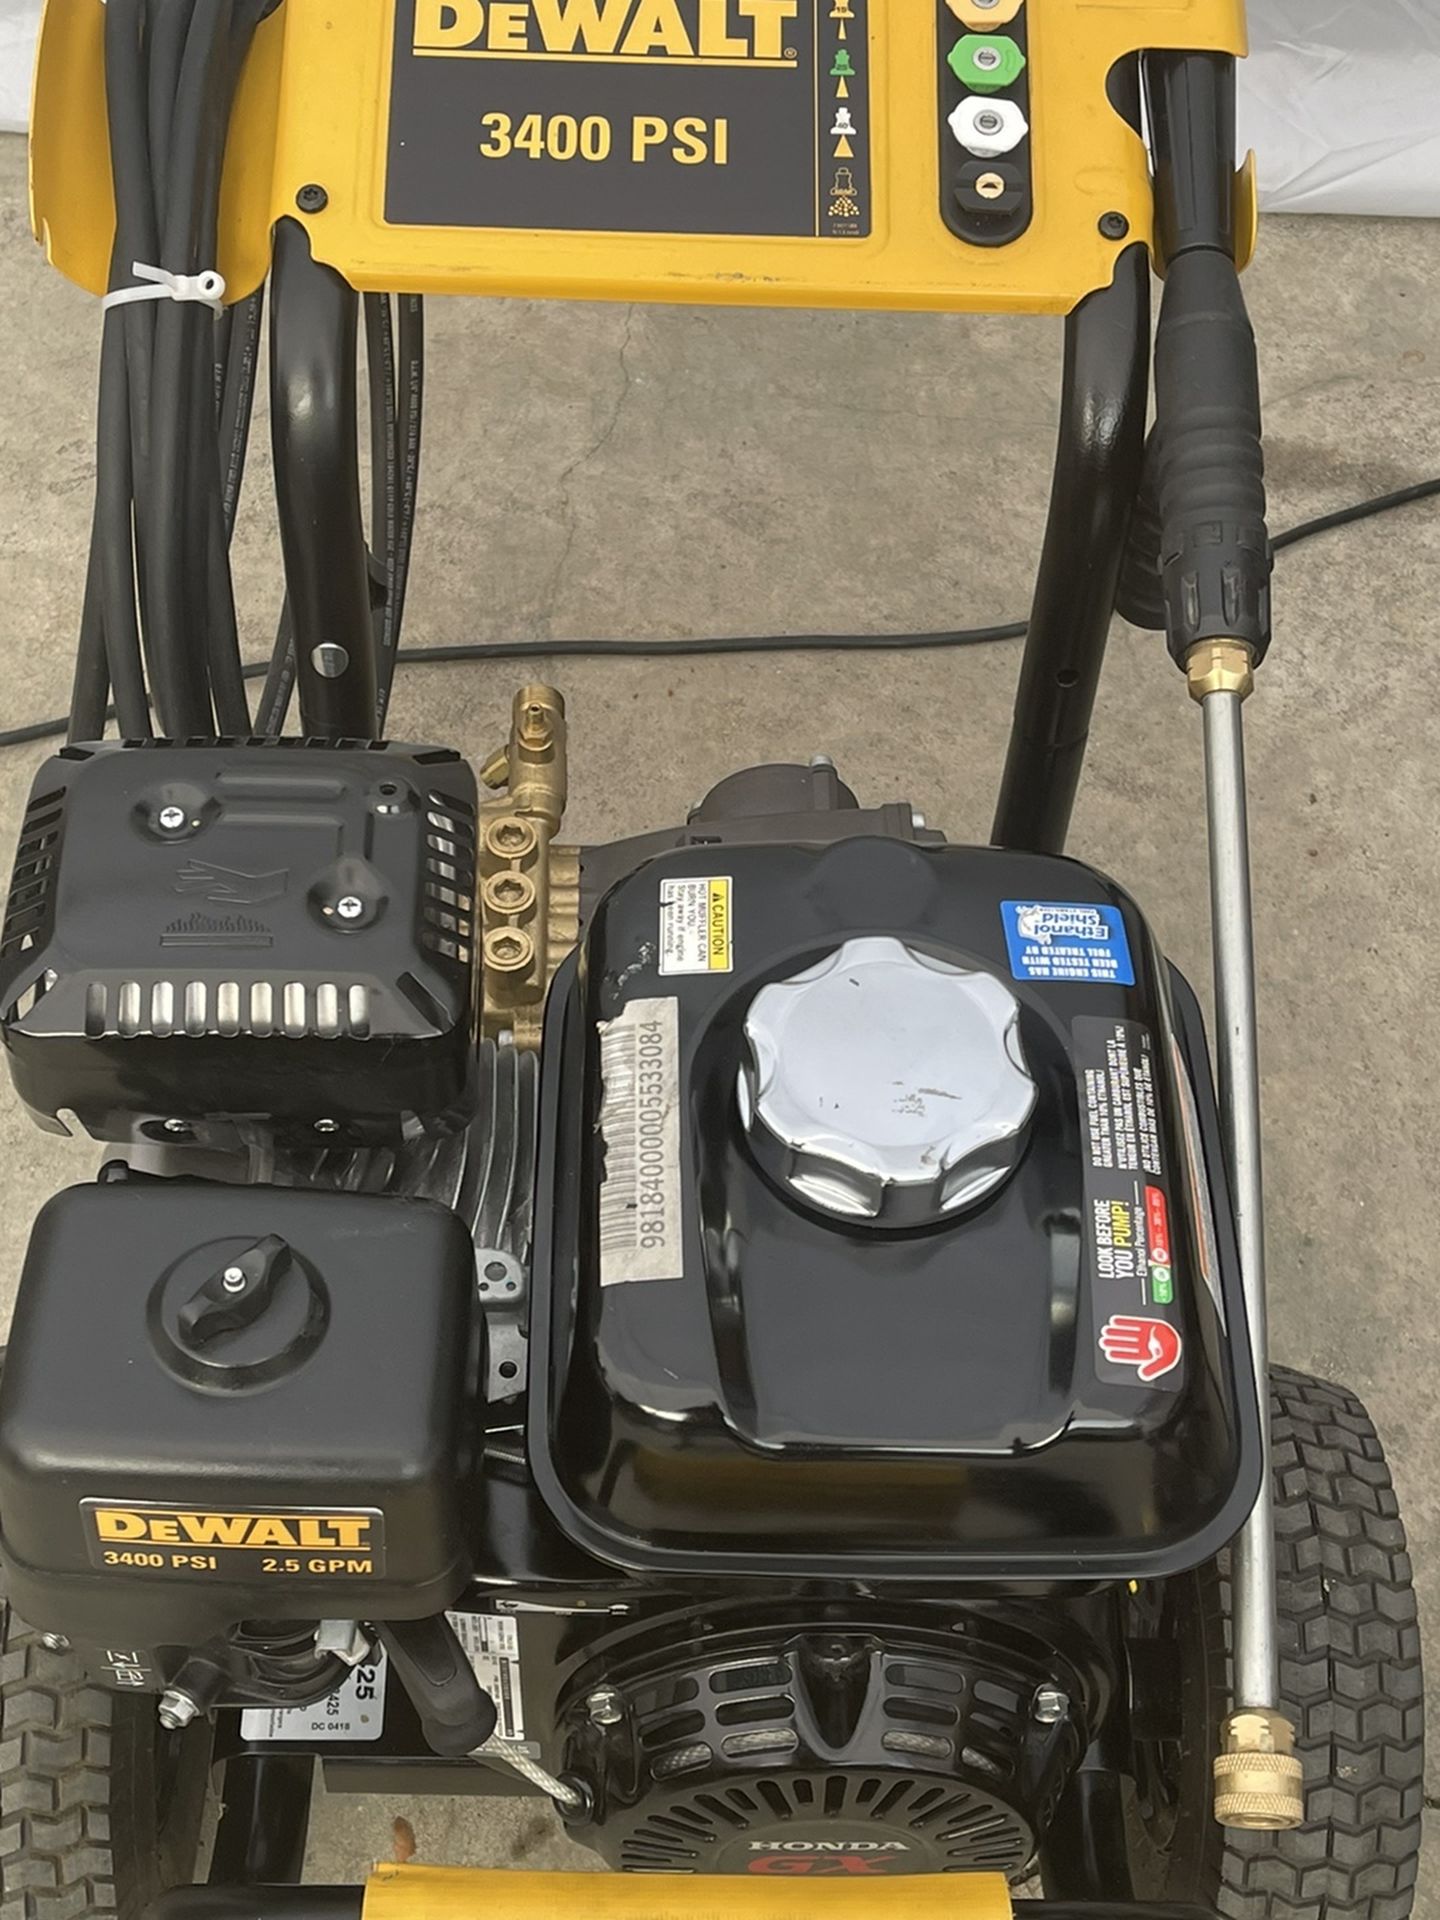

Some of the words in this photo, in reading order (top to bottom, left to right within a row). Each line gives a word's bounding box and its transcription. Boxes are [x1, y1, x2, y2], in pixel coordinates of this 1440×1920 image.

[413, 0, 797, 58] DEWALT
[480, 112, 611, 161] 3400
[632, 116, 729, 165] PSI
[667, 886, 675, 898] has
[677, 885, 685, 901] Stay
[687, 884, 696, 906] BURN
[676, 904, 684, 924] away
[698, 902, 706, 940] MUFFLER
[1042, 913, 1097, 925] Shield
[712, 904, 724, 955] CAUTION
[1033, 924, 1107, 938] Ethanol
[676, 934, 685, 961] engine
[698, 943, 706, 962] CAN
[1025, 946, 1039, 955] BY
[1021, 956, 1050, 966] WITH
[1052, 957, 1090, 967] TESTED
[1028, 966, 1050, 976] HAS
[1052, 967, 1089, 977] ENGINE
[1091, 968, 1116, 978] THIS
[1106, 1039, 1116, 1048] LA
[1088, 1110, 1099, 1126] FUEL
[1100, 1117, 1110, 1135] THAN
[1114, 1118, 1123, 1131] PAS
[1090, 1127, 1100, 1140] USE
[1091, 1141, 1101, 1155] NOT
[1092, 1156, 1102, 1167] DO
[1094, 1199, 1112, 1245] BEFORE
[1111, 1200, 1132, 1247] PUMP!
[1134, 1206, 1145, 1247] Percentage
[1097, 1247, 1114, 1278] LOOK
[1114, 1250, 1134, 1279] YOU
[1135, 1248, 1148, 1277] Ethanol
[95, 1511, 371, 1547] DEWALT
[104, 1551, 163, 1568] 3400
[171, 1555, 217, 1570] PSI
[262, 1559, 300, 1573] 2.5
[308, 1560, 373, 1574] GPM
[748, 1841, 910, 1851] HONDA
[747, 1855, 897, 1873] GX
